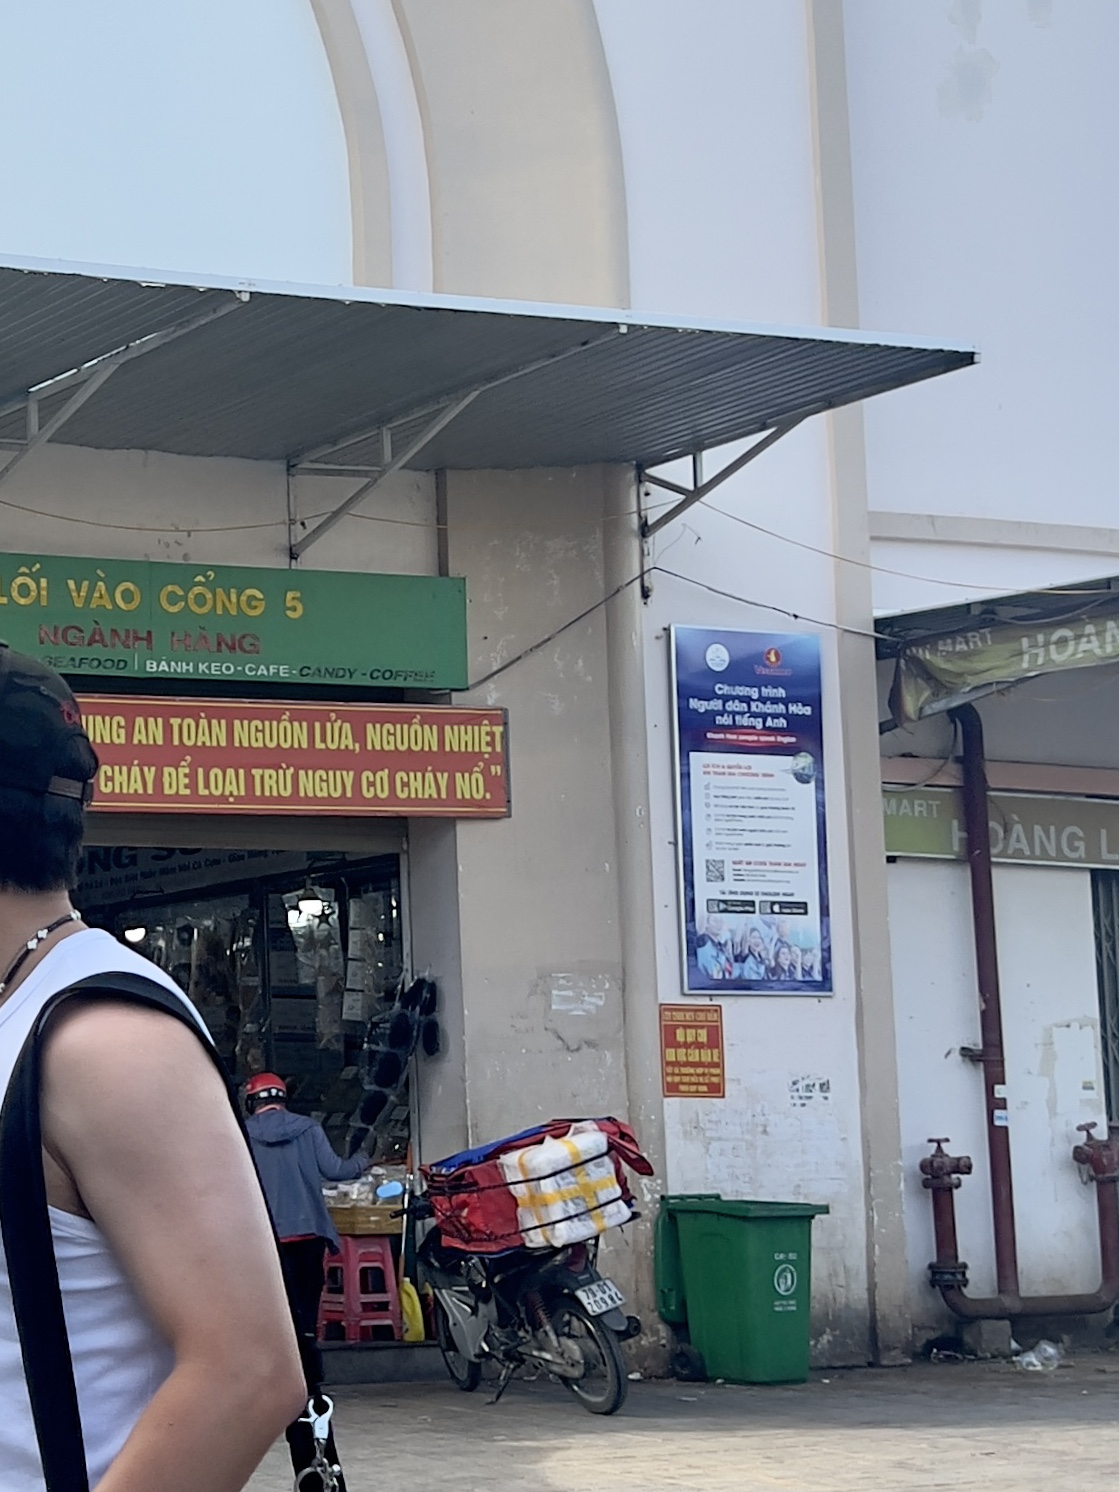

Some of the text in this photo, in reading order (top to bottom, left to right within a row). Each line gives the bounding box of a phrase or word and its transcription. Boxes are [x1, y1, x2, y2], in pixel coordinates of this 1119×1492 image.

[67, 569, 141, 611] VÀO
[159, 570, 266, 618] CỔNG
[285, 591, 304, 619] 5
[39, 620, 260, 655] NGÀNH HÀNG
[937, 627, 993, 656] MART
[146, 656, 193, 674] BÁNH
[714, 683, 759, 699] Chương
[133, 717, 163, 747] AN
[170, 712, 227, 747] TOÀN
[234, 711, 308, 750] NGUỒN
[314, 712, 360, 753] LỬA,
[366, 719, 439, 752] NGUỒN
[445, 724, 503, 759] NHIỆT
[765, 716, 787, 728] Anh
[99, 762, 156, 795] CHÁY
[162, 755, 191, 796] ĐỂ
[198, 767, 245, 802] LOẠI
[251, 764, 295, 797] TRỪ
[299, 768, 353, 799] NGUY
[361, 769, 390, 799] CƠ
[395, 764, 448, 799] CHÁY
[884, 799, 940, 819] MART
